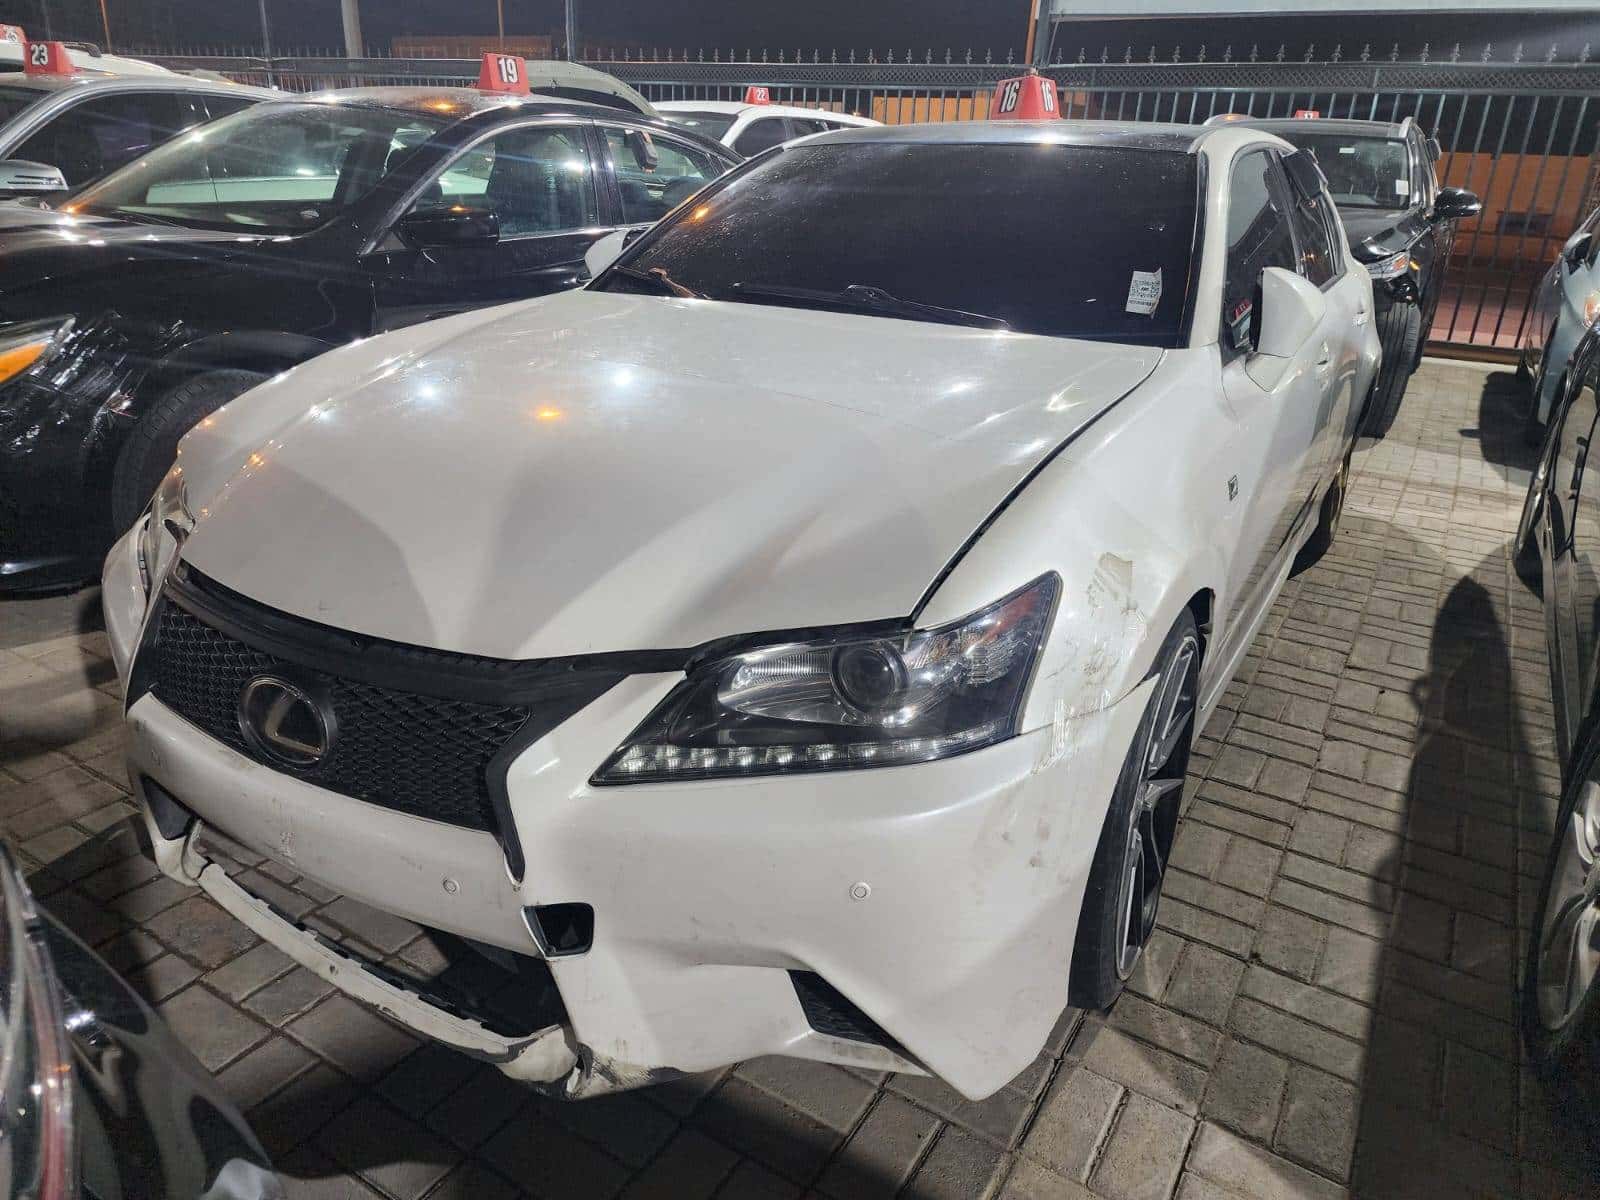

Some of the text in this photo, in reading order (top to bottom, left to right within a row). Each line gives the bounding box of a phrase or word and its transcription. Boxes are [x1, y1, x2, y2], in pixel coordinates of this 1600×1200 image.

[31, 43, 48, 66] 23
[498, 57, 518, 84] 19
[1000, 81, 1020, 113] 16
[1041, 81, 1054, 112] 16
